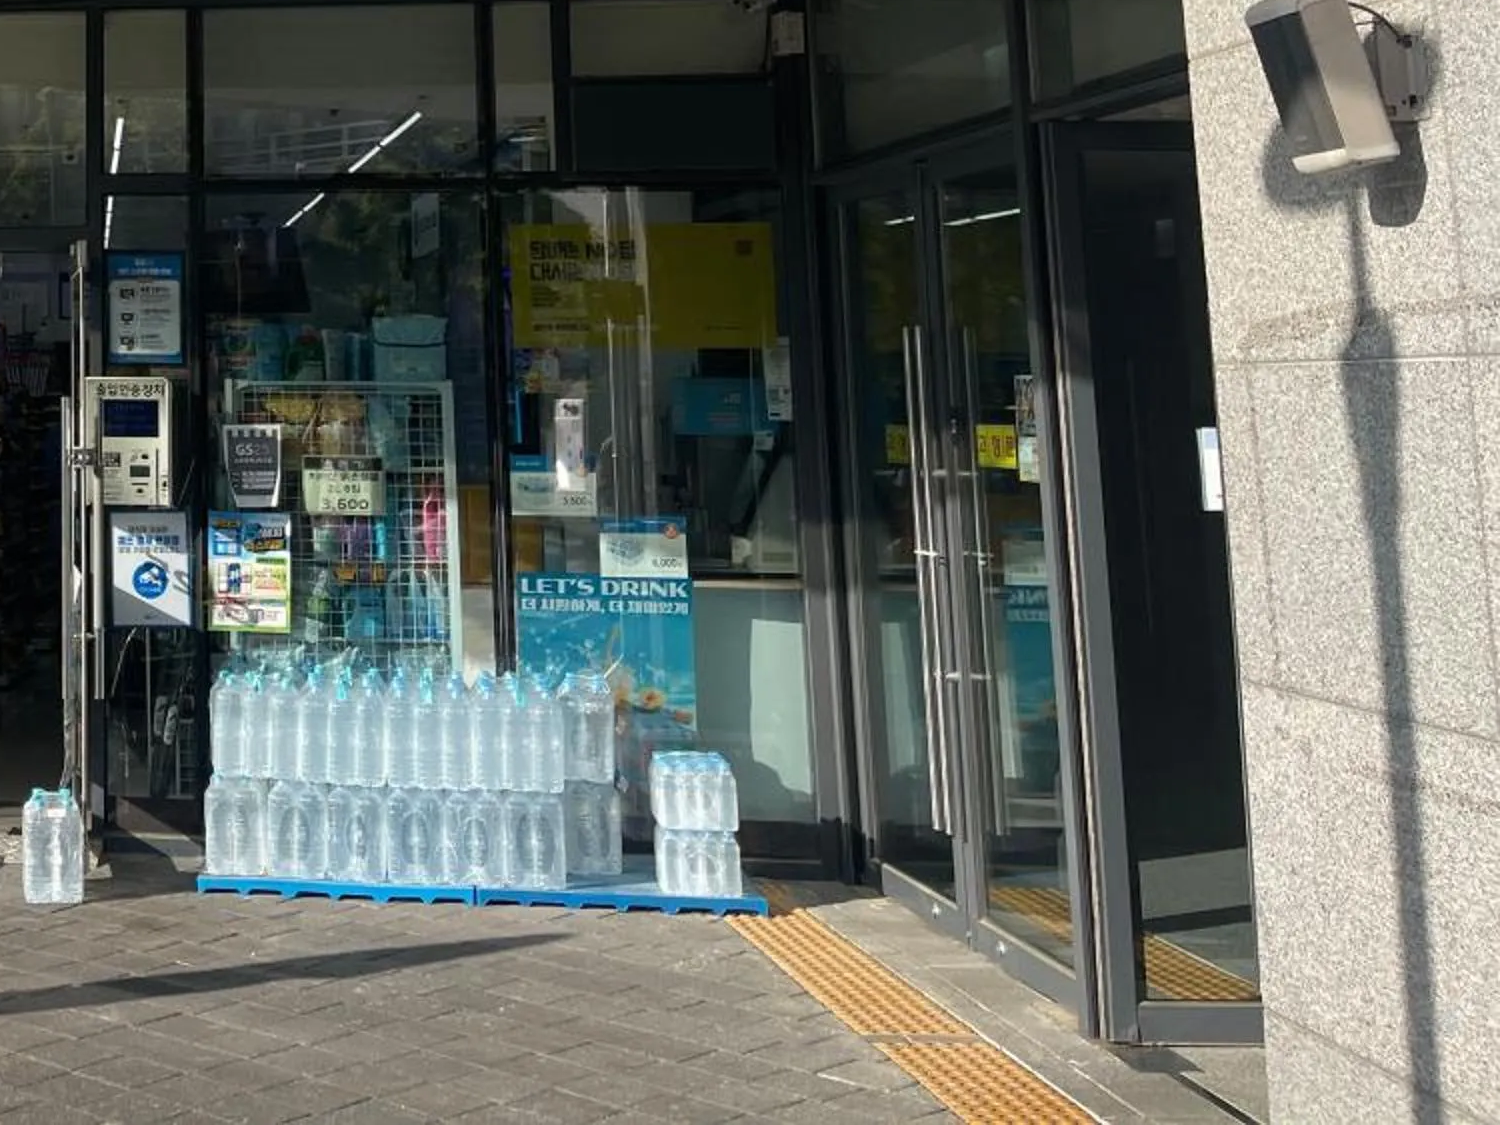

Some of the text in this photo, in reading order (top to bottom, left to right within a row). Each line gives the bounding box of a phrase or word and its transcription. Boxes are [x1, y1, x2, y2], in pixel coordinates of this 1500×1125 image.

[97, 382, 165, 397] 출입인증장치
[521, 577, 688, 598] LET'S DRINK
